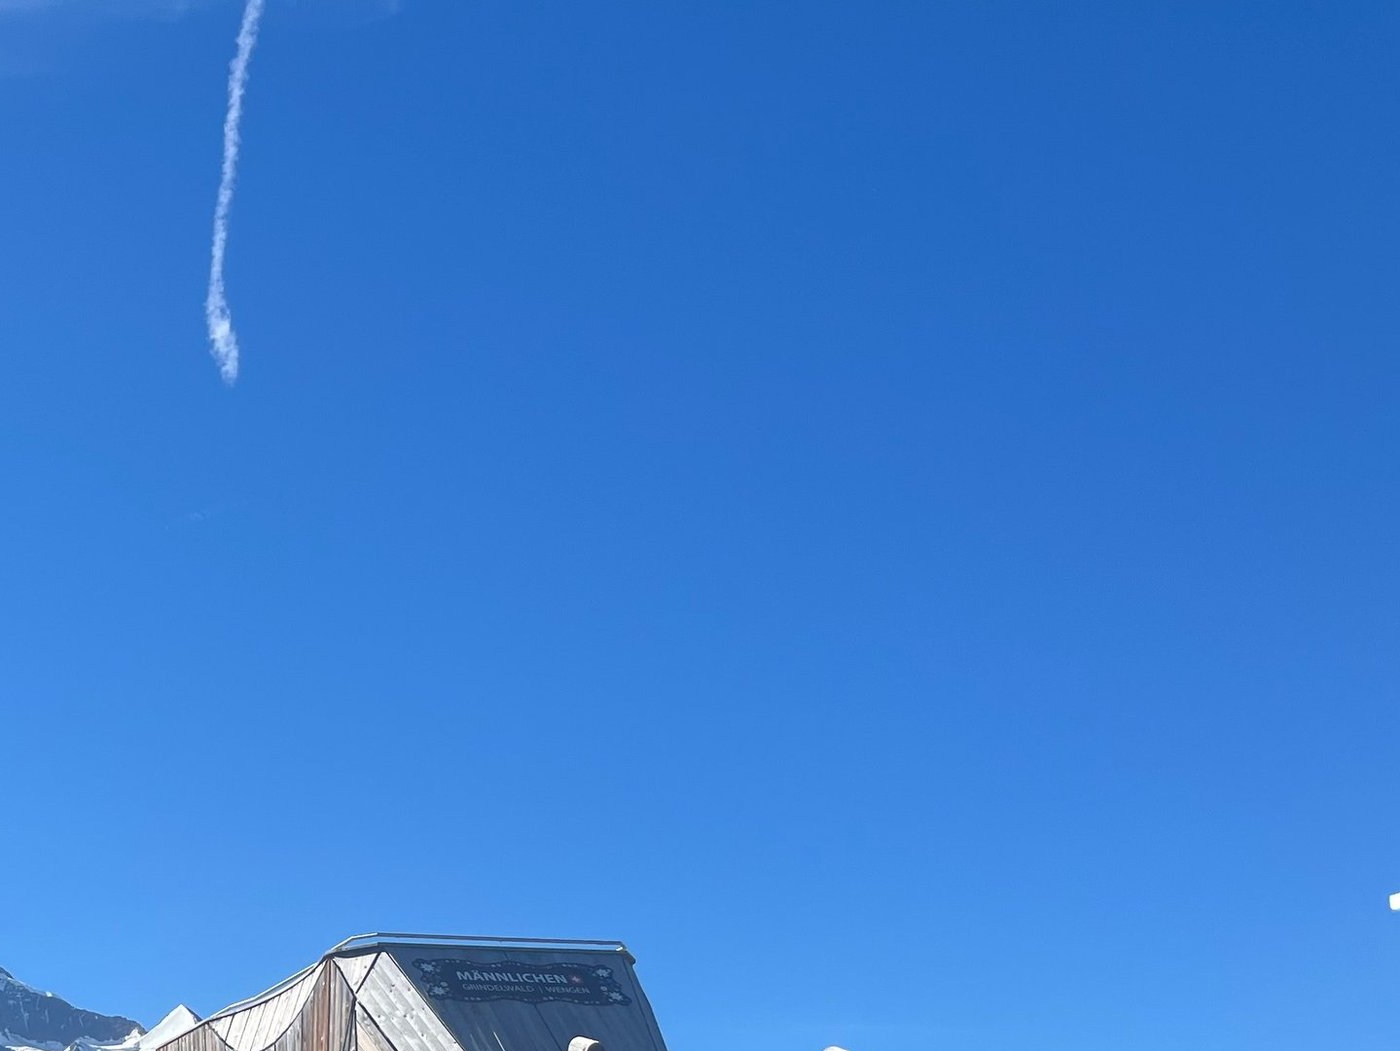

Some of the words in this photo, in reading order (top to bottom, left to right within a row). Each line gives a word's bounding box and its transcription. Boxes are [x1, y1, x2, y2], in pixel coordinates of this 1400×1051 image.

[456, 970, 568, 984] MÄNNLICHEN
[462, 984, 535, 993] GRINDELWALD
[545, 985, 590, 994] WENGEN
